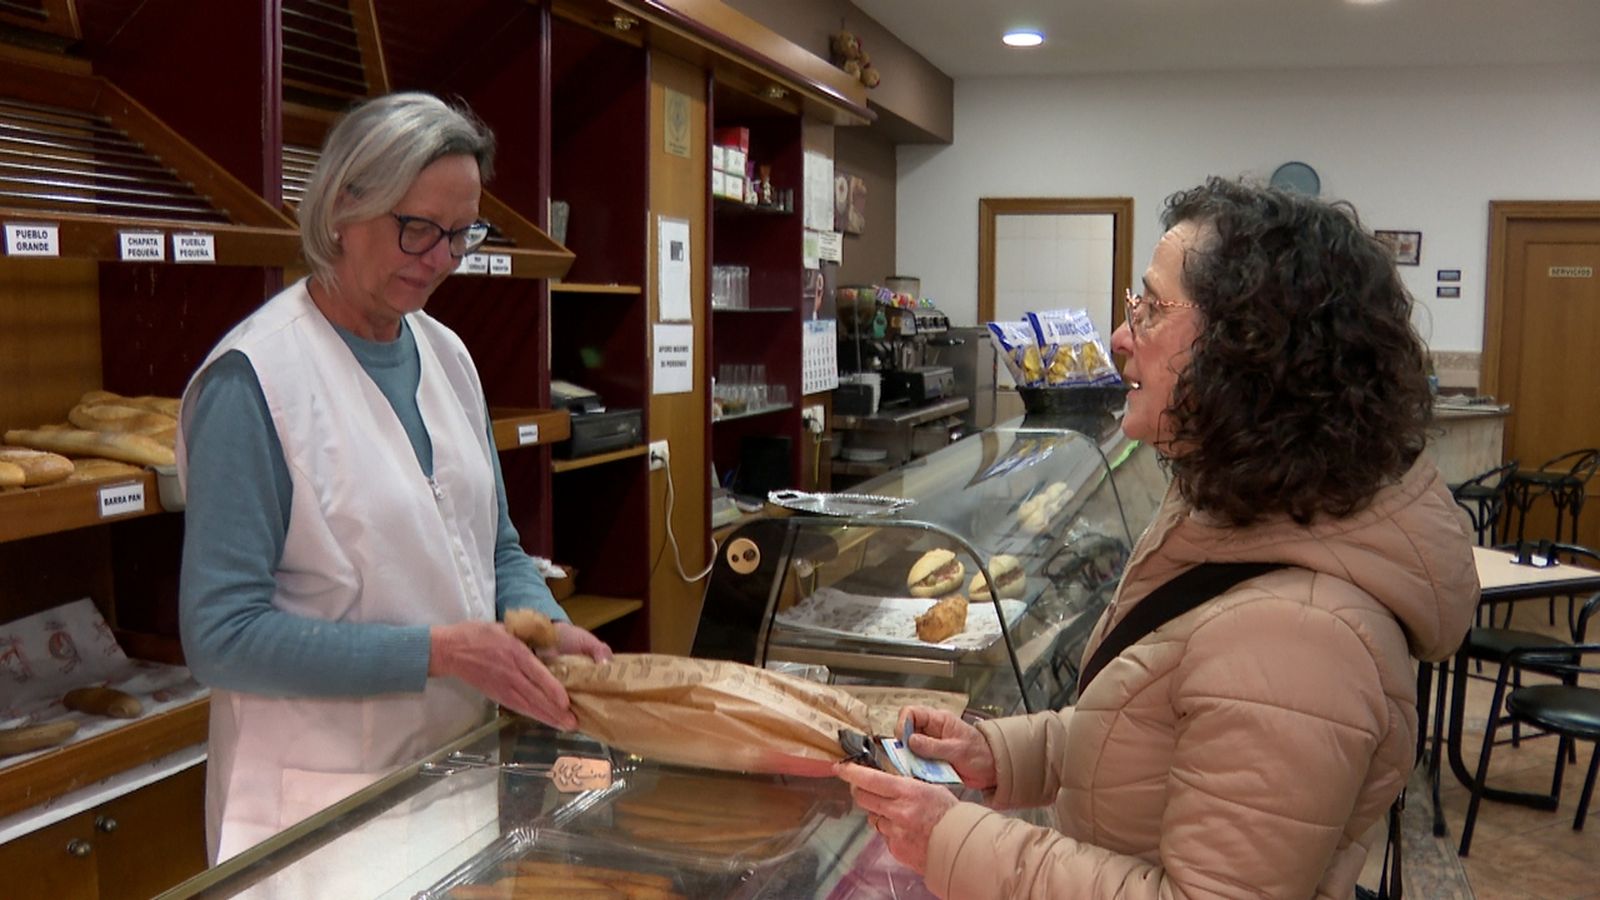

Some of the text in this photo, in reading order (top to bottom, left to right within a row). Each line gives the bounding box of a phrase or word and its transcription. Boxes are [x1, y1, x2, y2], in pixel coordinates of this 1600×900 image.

[15, 229, 48, 240] PUEBLO
[16, 241, 49, 252] GRANDE
[127, 237, 159, 247] CHAPATA
[180, 238, 206, 247] PUEBLO
[127, 247, 160, 257] PEQUEÑA
[179, 247, 209, 257] PEQUEÑA
[1552, 268, 1591, 277] SERVICIOS
[104, 494, 141, 506] BARRA PAN
